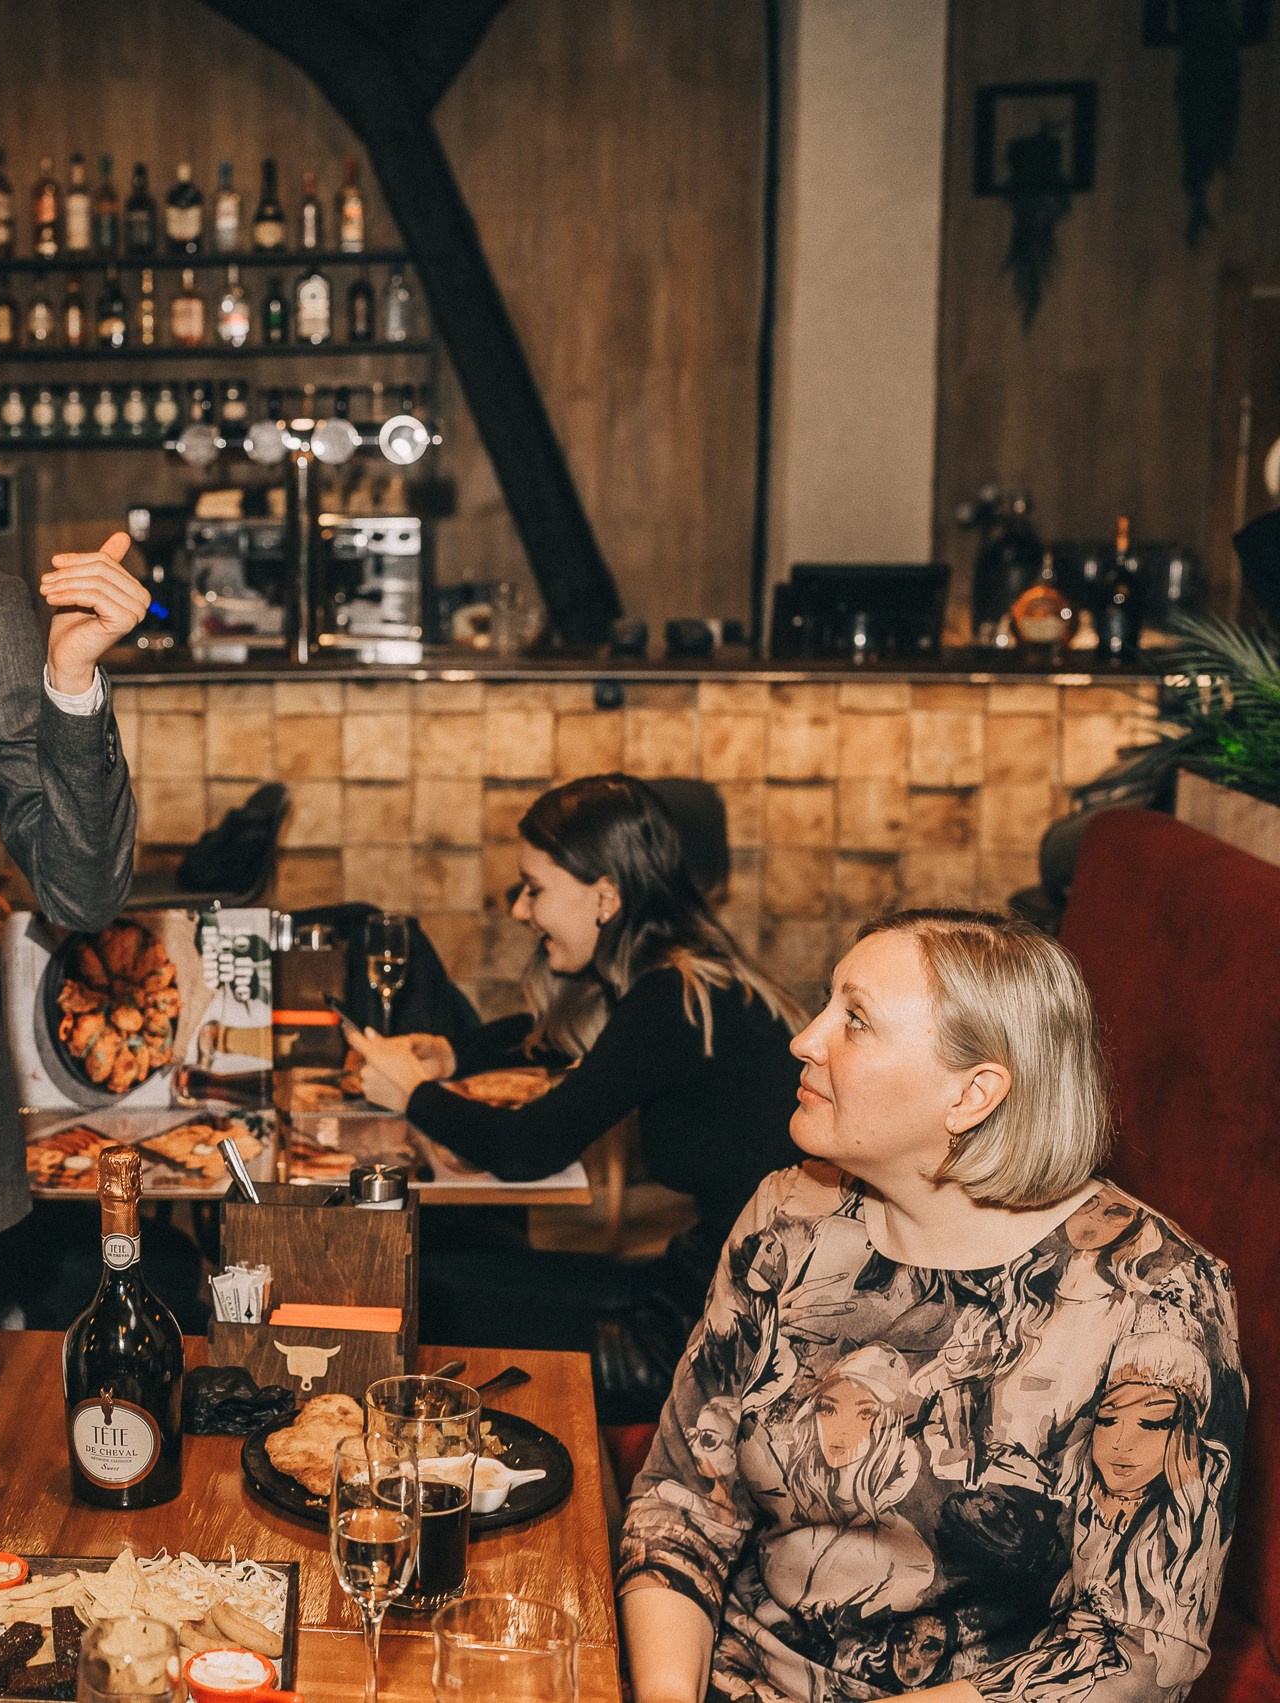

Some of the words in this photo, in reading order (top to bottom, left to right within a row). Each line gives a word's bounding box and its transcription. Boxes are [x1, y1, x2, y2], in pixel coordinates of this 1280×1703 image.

[91, 1426, 128, 1446] TÊTE
[85, 1445, 96, 1453] DE
[99, 1448, 138, 1456] CHEVAL
